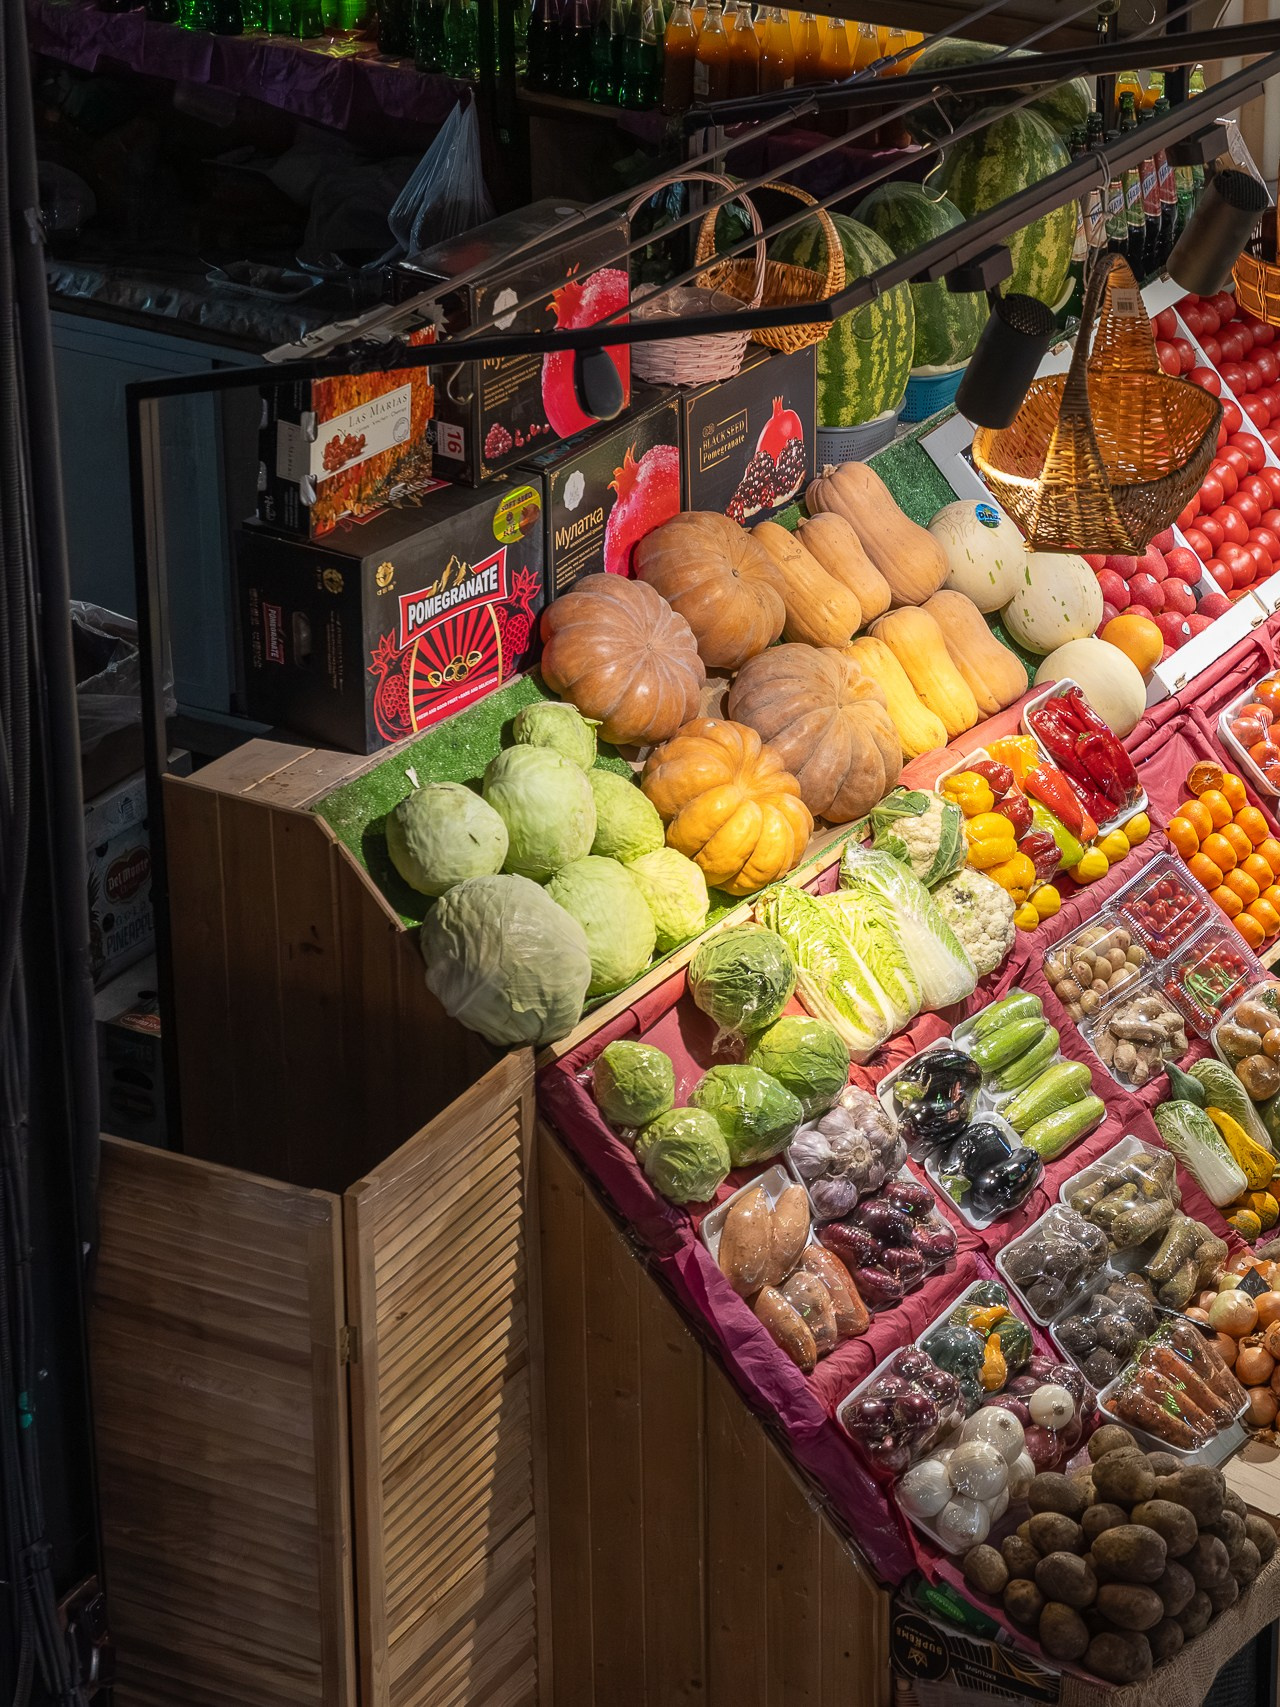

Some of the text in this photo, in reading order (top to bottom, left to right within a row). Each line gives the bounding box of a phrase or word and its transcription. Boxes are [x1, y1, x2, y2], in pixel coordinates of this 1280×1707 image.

[348, 410, 367, 428] LAS
[369, 393, 408, 418] MARIAS
[447, 431, 462, 454] 16
[702, 420, 745, 451] BLACK SEED
[703, 434, 745, 463] Pomegranate
[555, 507, 604, 551] Мулатка
[408, 563, 499, 632] POMEGRANATE
[268, 608, 280, 659] POMEGRANATE
[106, 914, 154, 956] PINEAPPL
